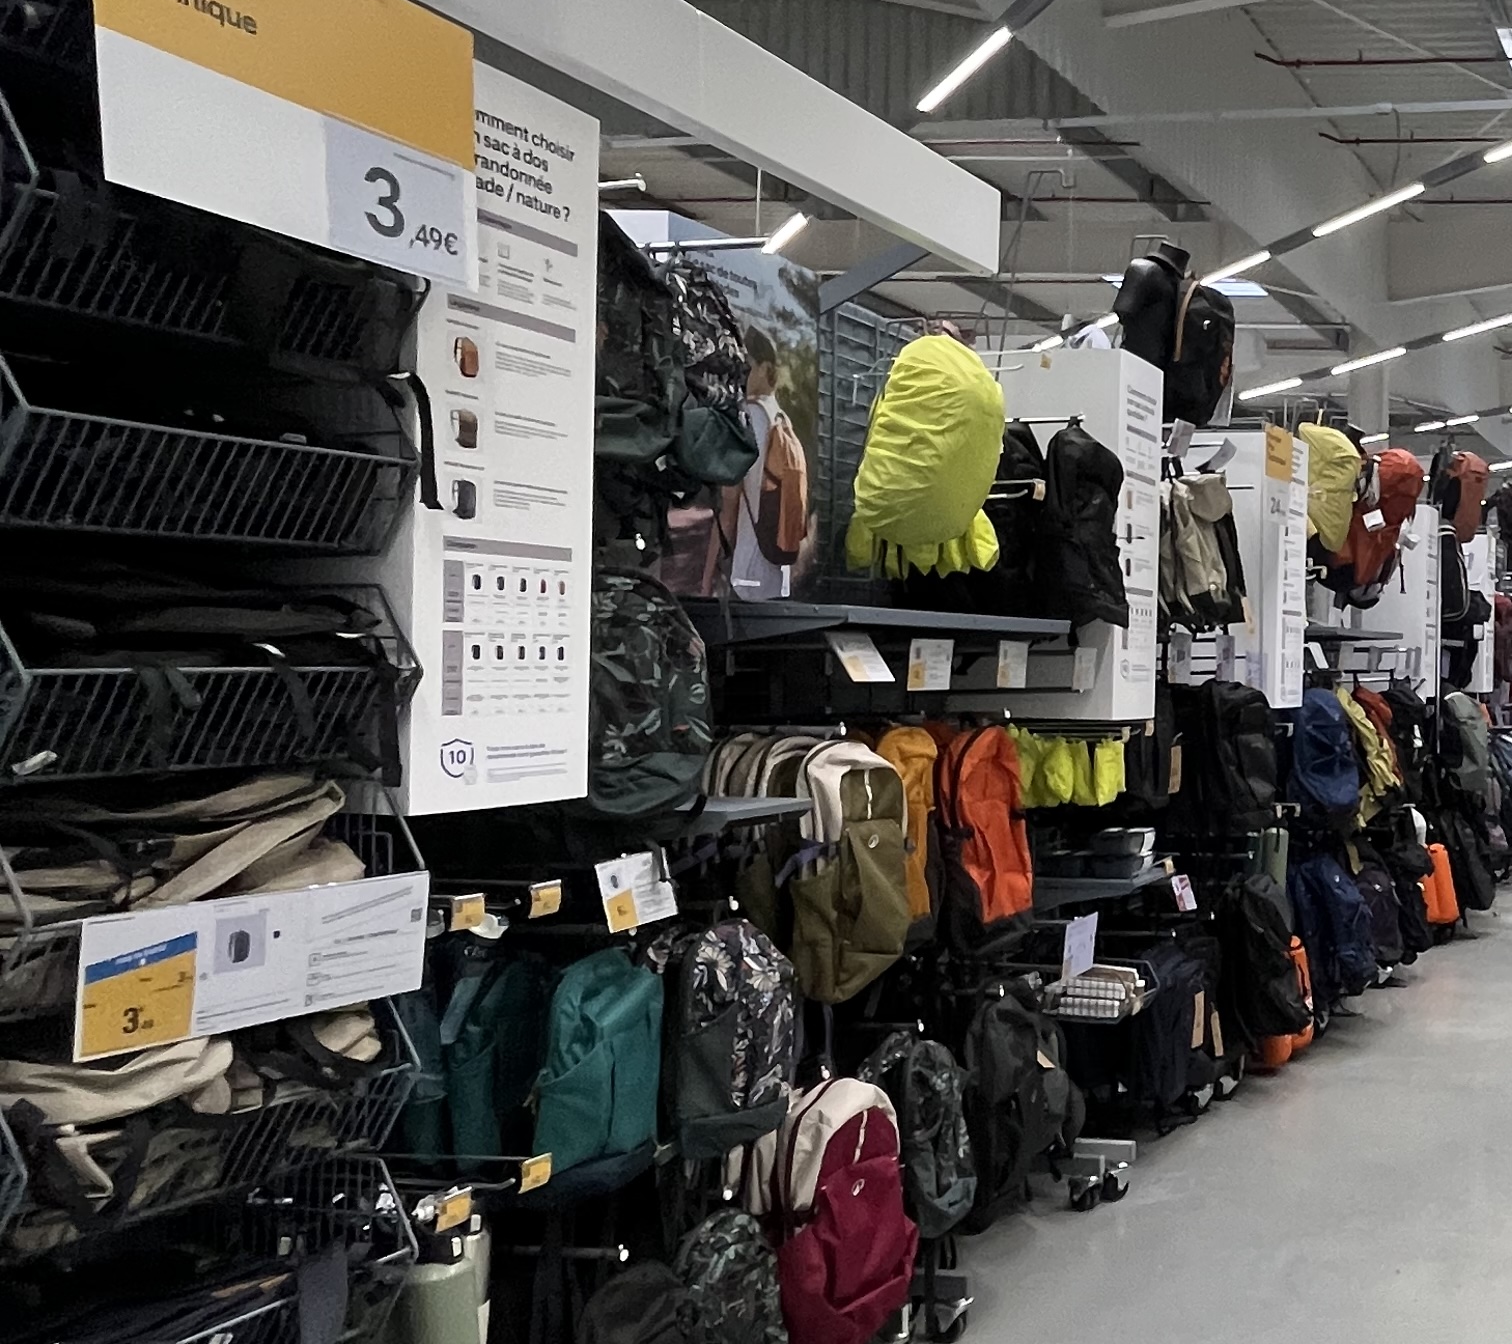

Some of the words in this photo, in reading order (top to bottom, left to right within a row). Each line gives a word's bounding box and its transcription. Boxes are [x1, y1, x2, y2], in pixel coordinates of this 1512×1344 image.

[475, 109, 529, 142] mment
[483, 134, 509, 156] sac
[512, 142, 521, 160] à
[523, 148, 549, 172] dos
[474, 153, 553, 195] randonnée
[449, 749, 467, 765] 10
